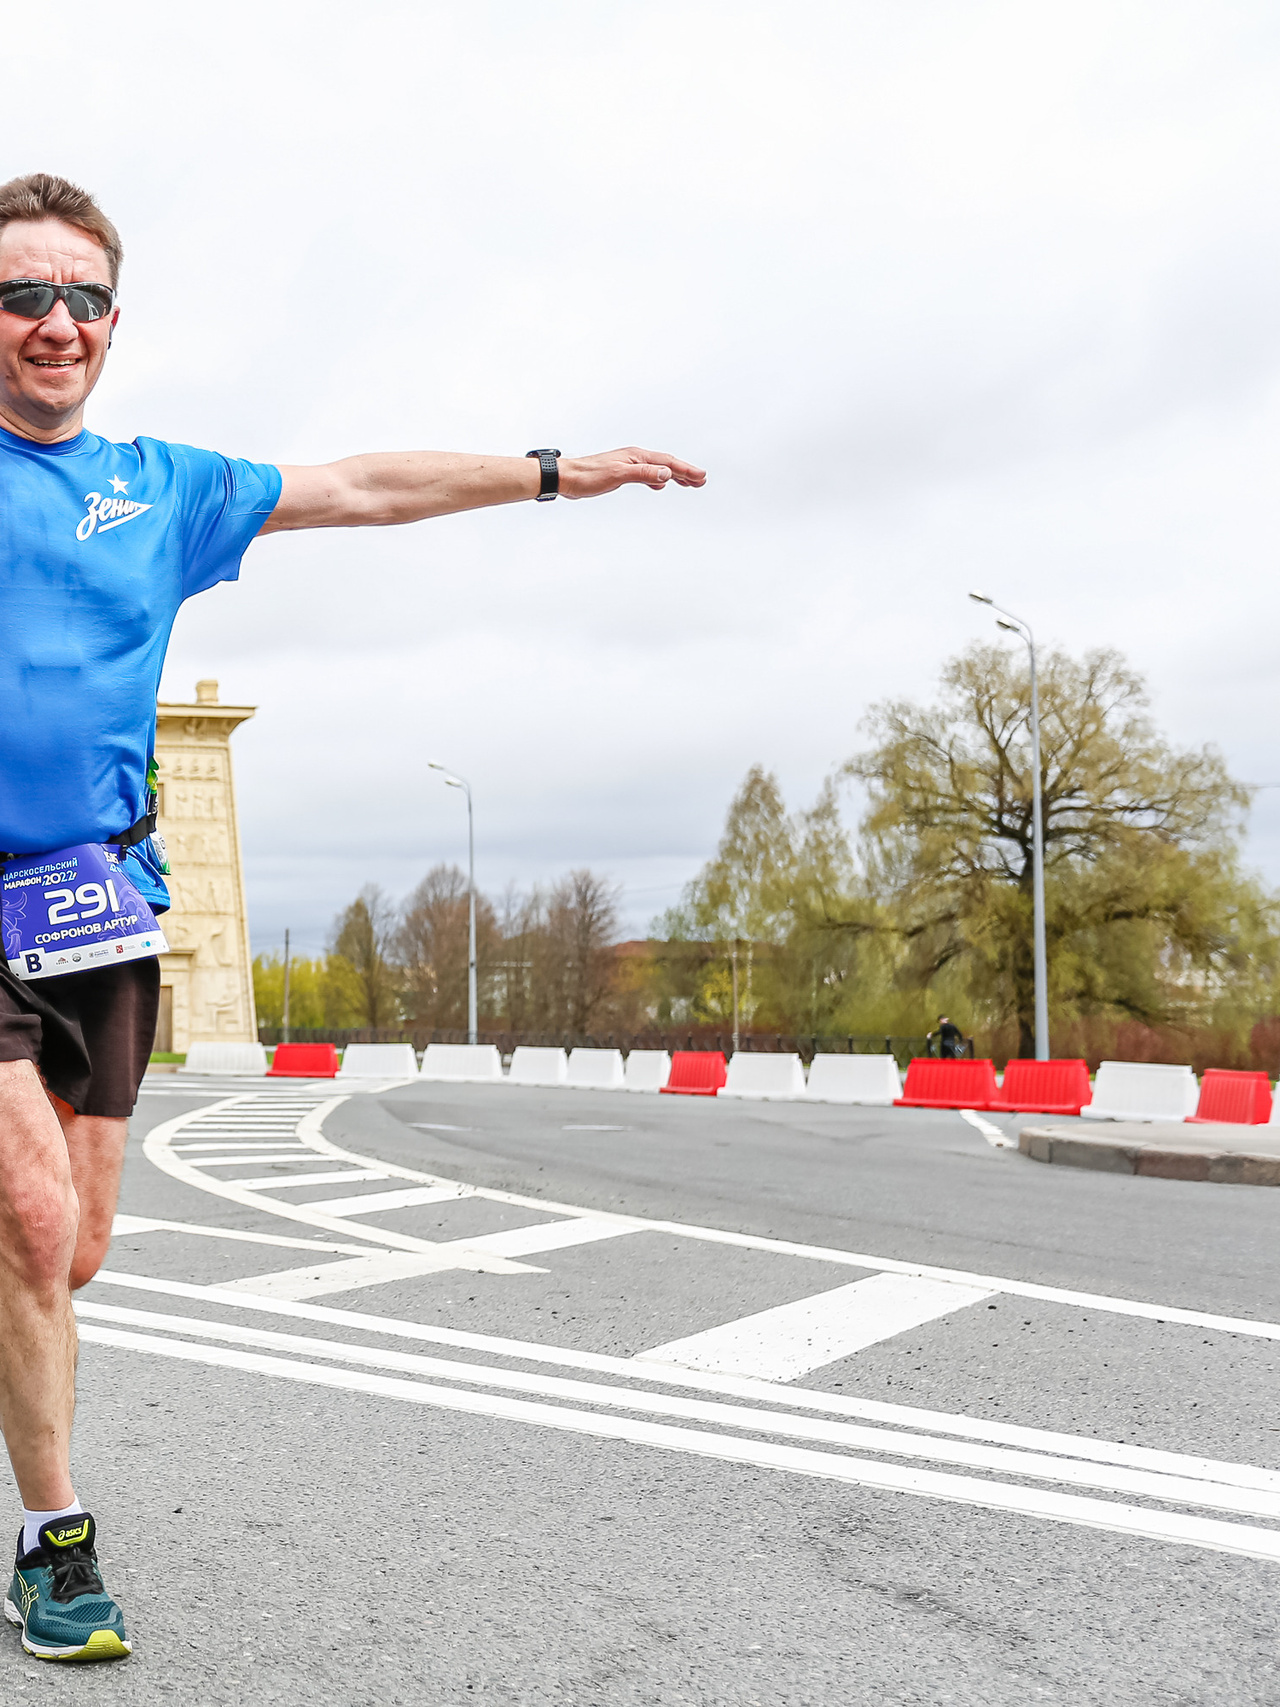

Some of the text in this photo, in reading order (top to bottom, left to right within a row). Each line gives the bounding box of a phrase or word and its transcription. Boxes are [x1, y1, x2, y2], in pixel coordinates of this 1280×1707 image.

[3, 857, 78, 881] ЦАРСКОСЕЛЬСКИЙ
[4, 876, 42, 891] МАРАФОН
[44, 879, 121, 926] 291
[34, 915, 138, 945] СОФРОНОВ АРТУР
